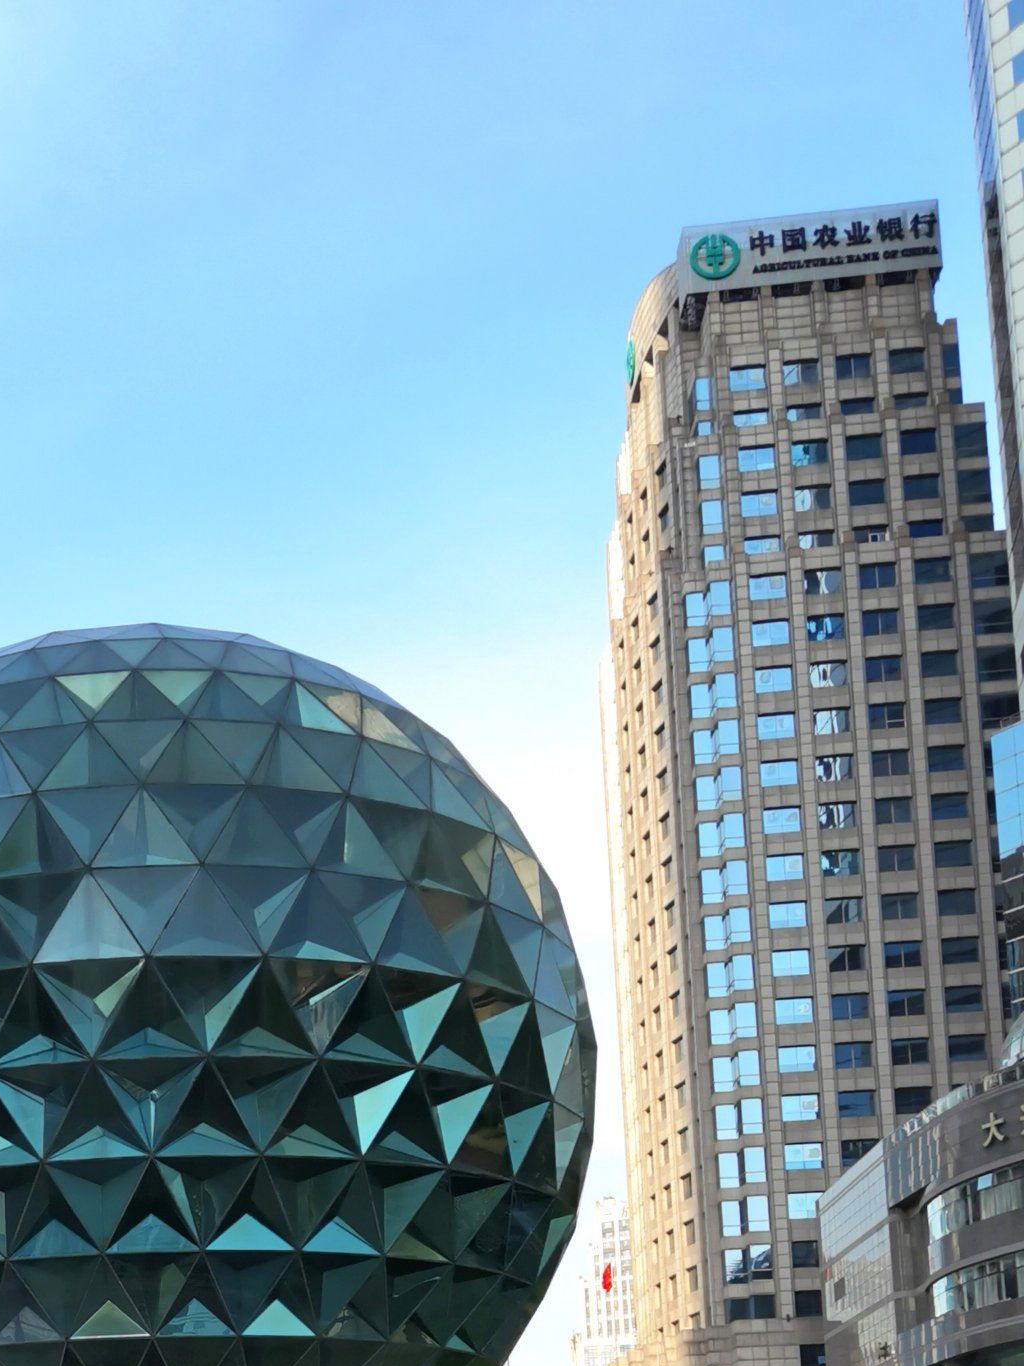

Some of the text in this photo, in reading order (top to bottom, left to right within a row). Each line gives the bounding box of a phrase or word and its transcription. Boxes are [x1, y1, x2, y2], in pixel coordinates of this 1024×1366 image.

[749, 212, 937, 257] 中国农业银行
[752, 246, 938, 274] AGRICULTURAL BANK OF CHINA
[981, 1104, 1024, 1148] 大
